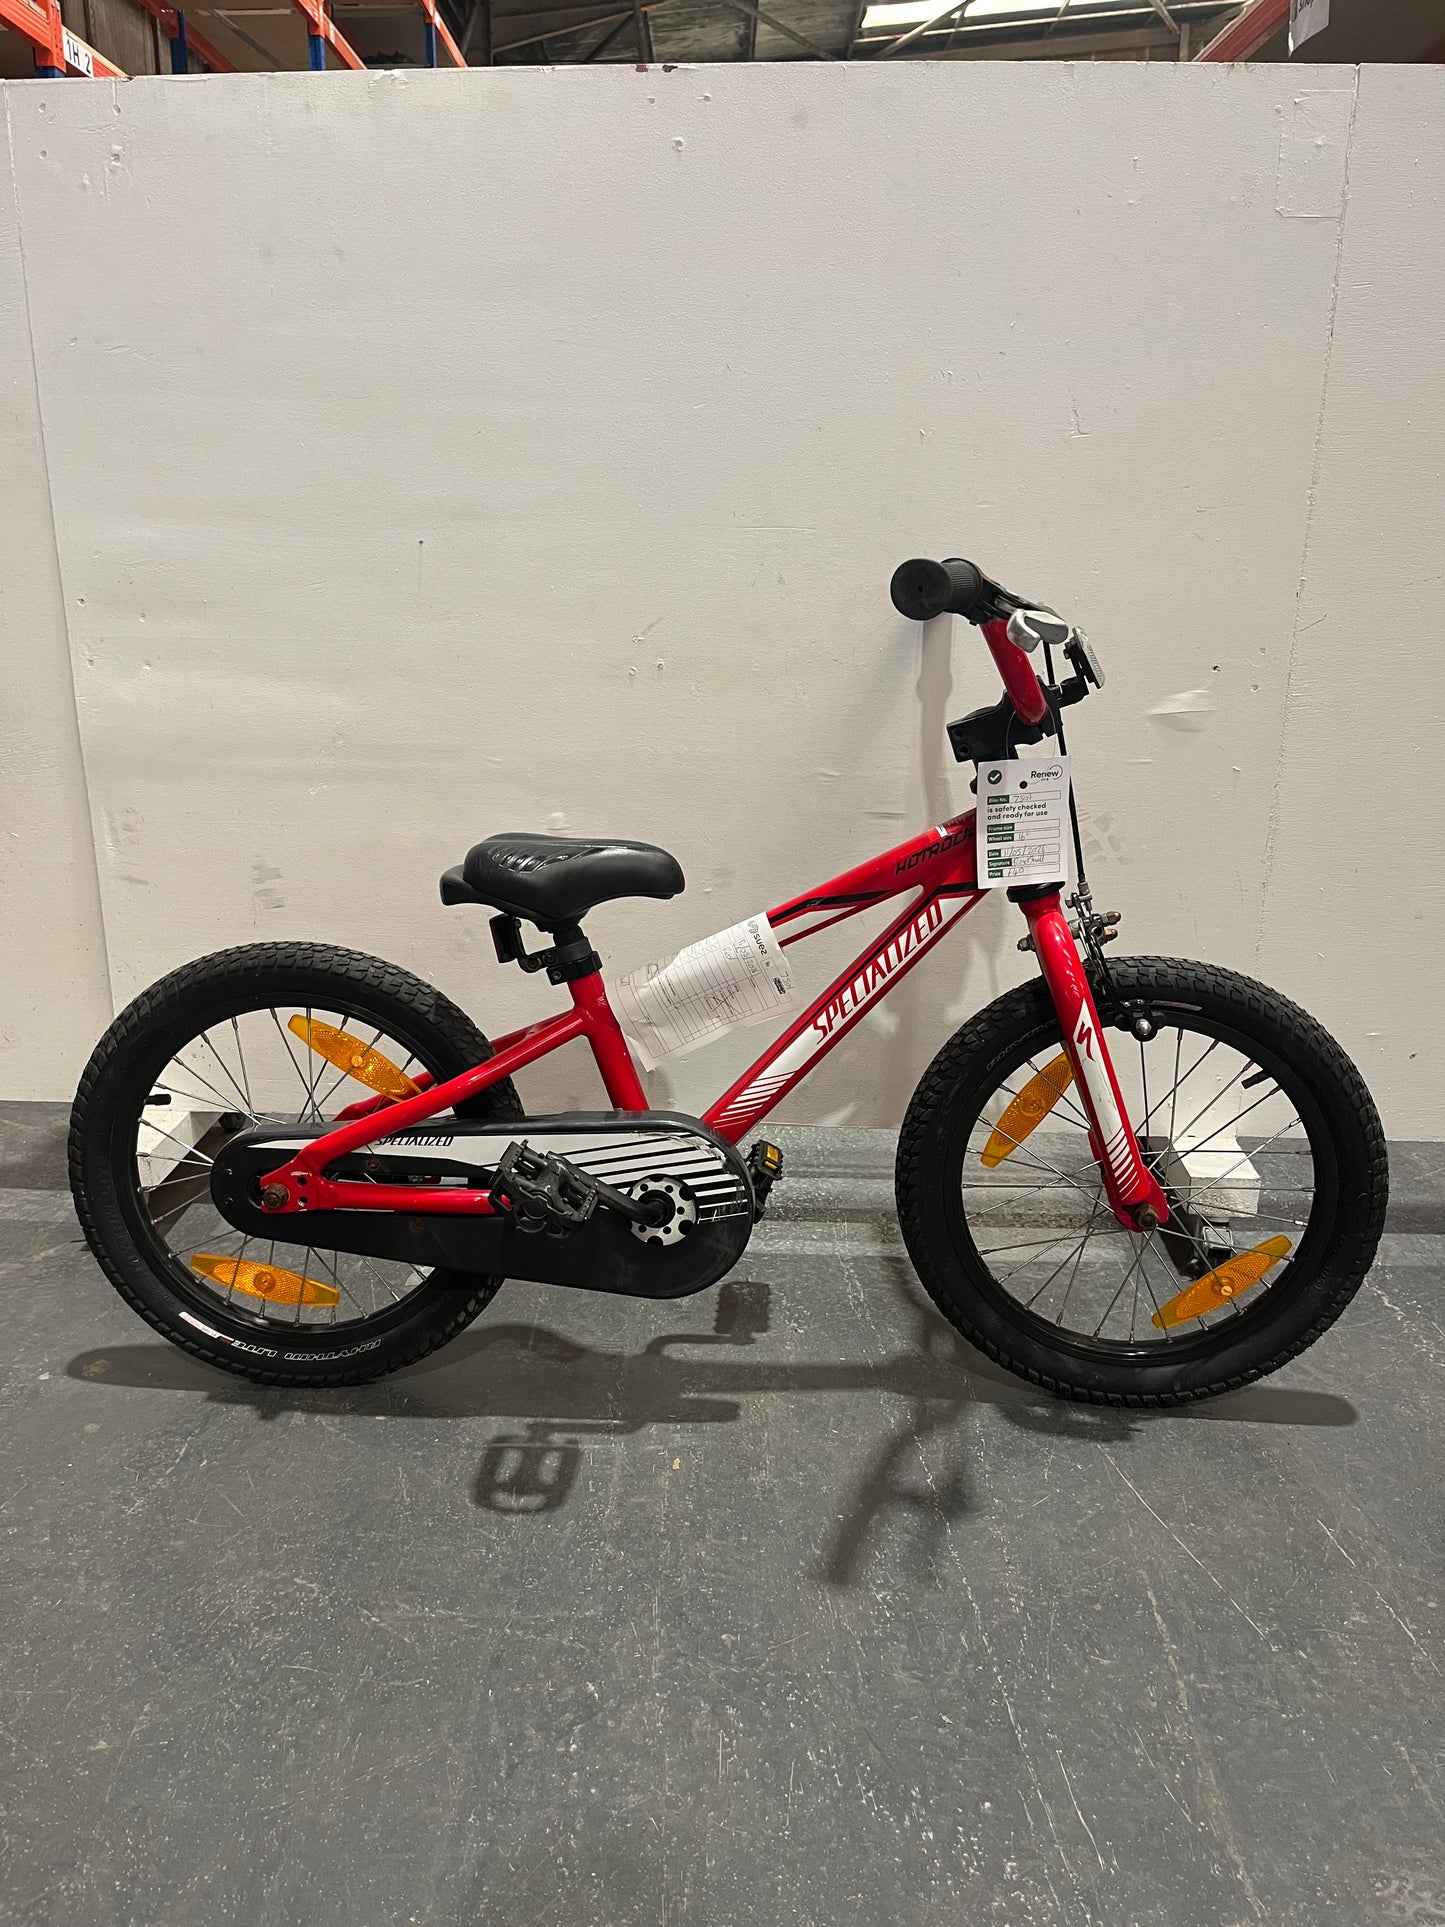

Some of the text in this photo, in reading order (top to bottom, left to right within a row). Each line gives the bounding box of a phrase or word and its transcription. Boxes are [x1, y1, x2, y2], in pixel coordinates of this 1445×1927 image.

[66, 38, 92, 75] 1H 2
[1030, 770, 1060, 779] Renew
[994, 804, 1016, 813] safety
[1017, 802, 1047, 811] checked
[1002, 811, 1023, 819] ready
[753, 933, 768, 956] suez
[812, 899, 943, 1045] SPECIALIZED
[375, 1135, 455, 1146] SPECIALIZED
[230, 1339, 279, 1358] LITE
[284, 1337, 383, 1361] RHYTHM
